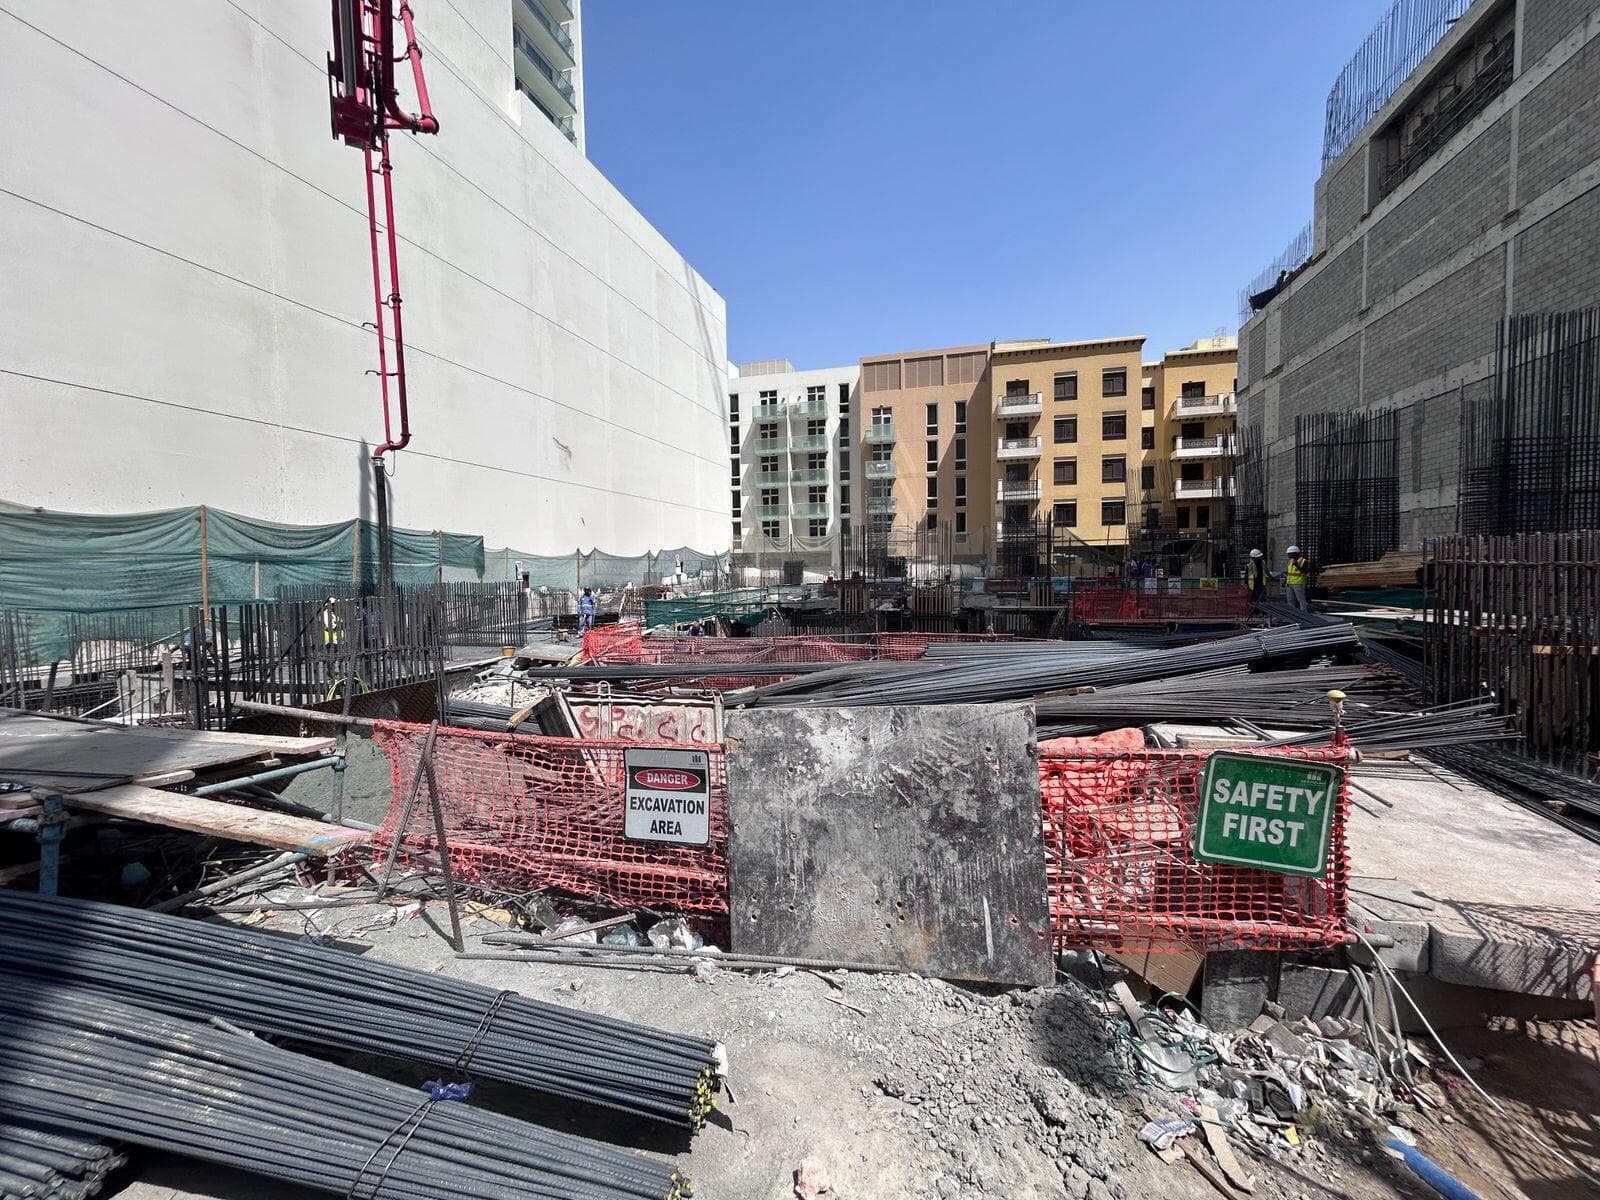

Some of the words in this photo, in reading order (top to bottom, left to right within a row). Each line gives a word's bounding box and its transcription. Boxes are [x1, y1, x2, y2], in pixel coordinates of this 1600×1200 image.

[646, 772, 688, 785] DANGER
[630, 796, 705, 815] EXCAVATION
[1213, 778, 1324, 815] SAFETY
[650, 819, 683, 836] AREA
[1222, 812, 1305, 847] FIRST
